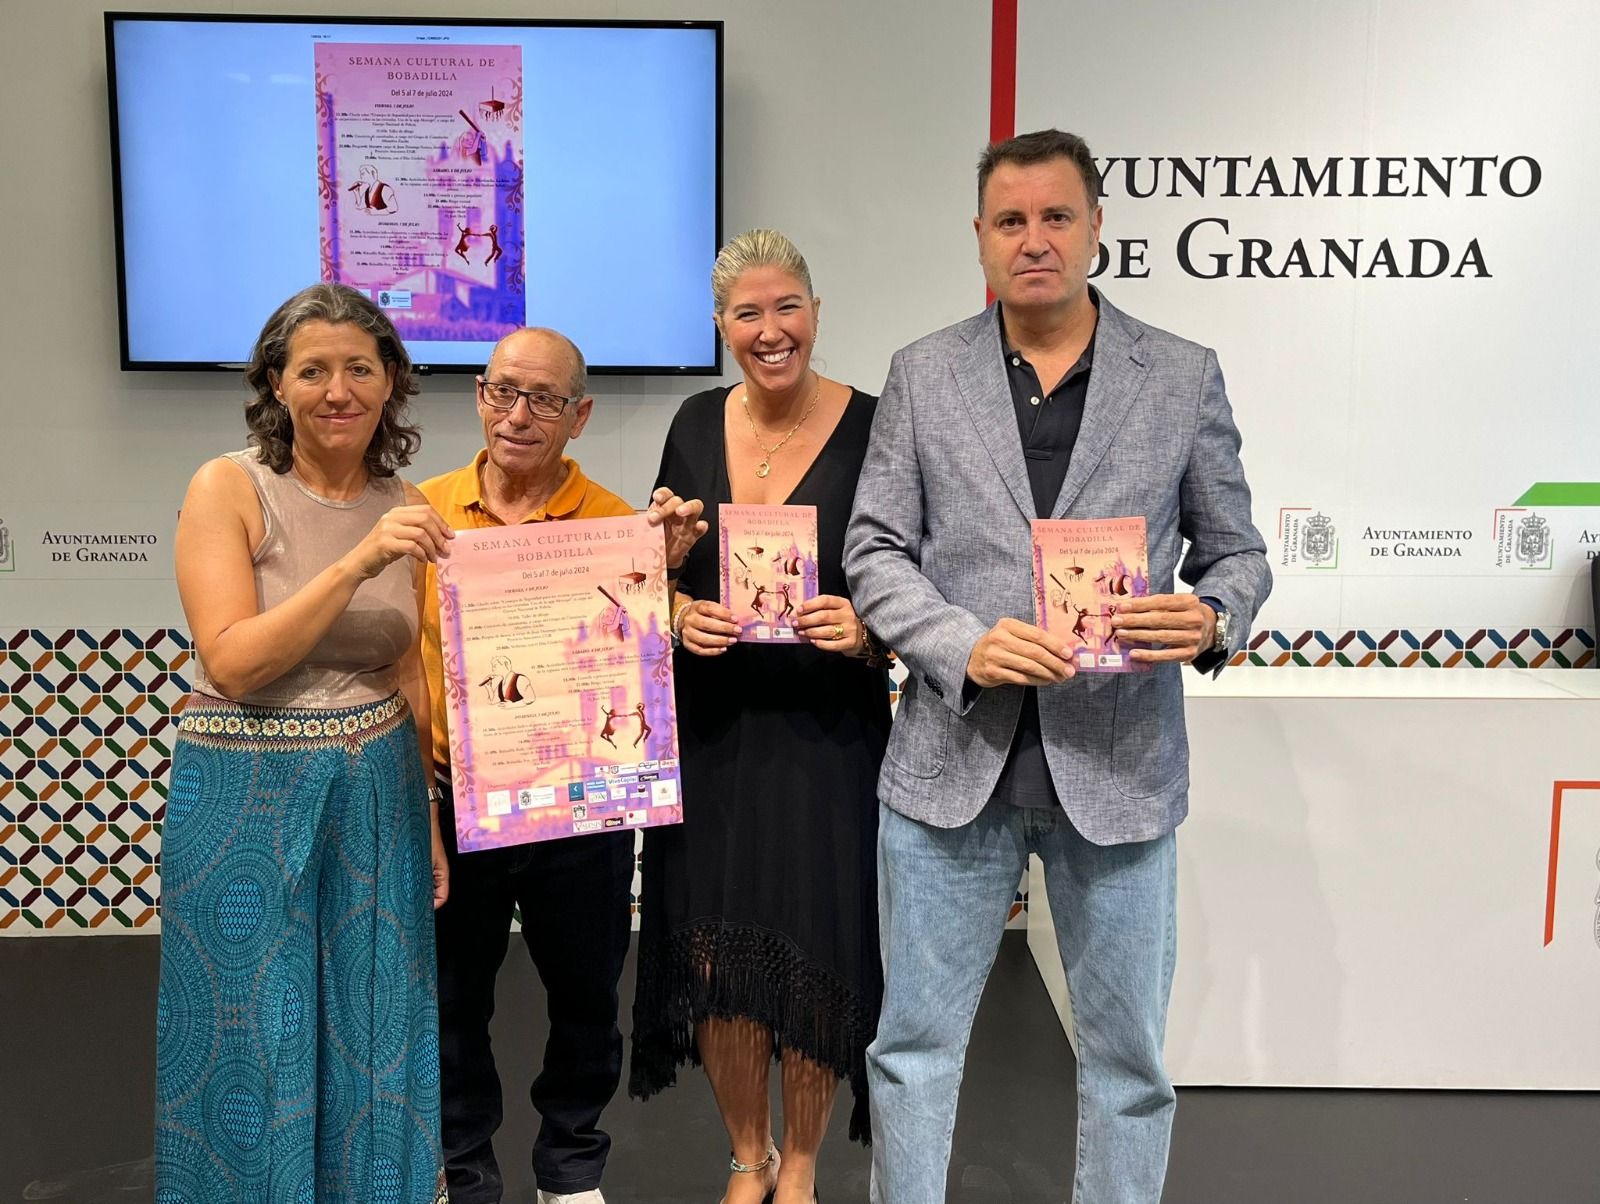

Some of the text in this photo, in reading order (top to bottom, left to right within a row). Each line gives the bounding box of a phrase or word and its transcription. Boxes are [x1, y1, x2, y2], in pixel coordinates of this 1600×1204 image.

[349, 57, 495, 67] SEMANA CULTURAL DE
[387, 72, 457, 81] BOBADILLA
[391, 89, 400, 97] Del
[425, 90, 438, 99] julio
[1092, 155, 1543, 198] YUNTAMIENTO
[1176, 217, 1494, 280] GRANADA
[1076, 525, 1125, 533] CULTURAL
[1362, 526, 1473, 540] AYUNTAMIENTO
[42, 530, 157, 546] AYUNTAMIENTO
[473, 528, 635, 551] SEMANA CULTURAL DE
[1063, 535, 1114, 543] BOBADILLA
[52, 547, 148, 562] DE GRANADA
[517, 547, 594, 563] BOBADILLA
[1091, 548, 1104, 556] julio
[1370, 543, 1462, 557] DE GRANADA
[522, 571, 532, 580] Del
[551, 569, 558, 577] de
[559, 567, 573, 578] julio
[574, 566, 590, 575] 2024
